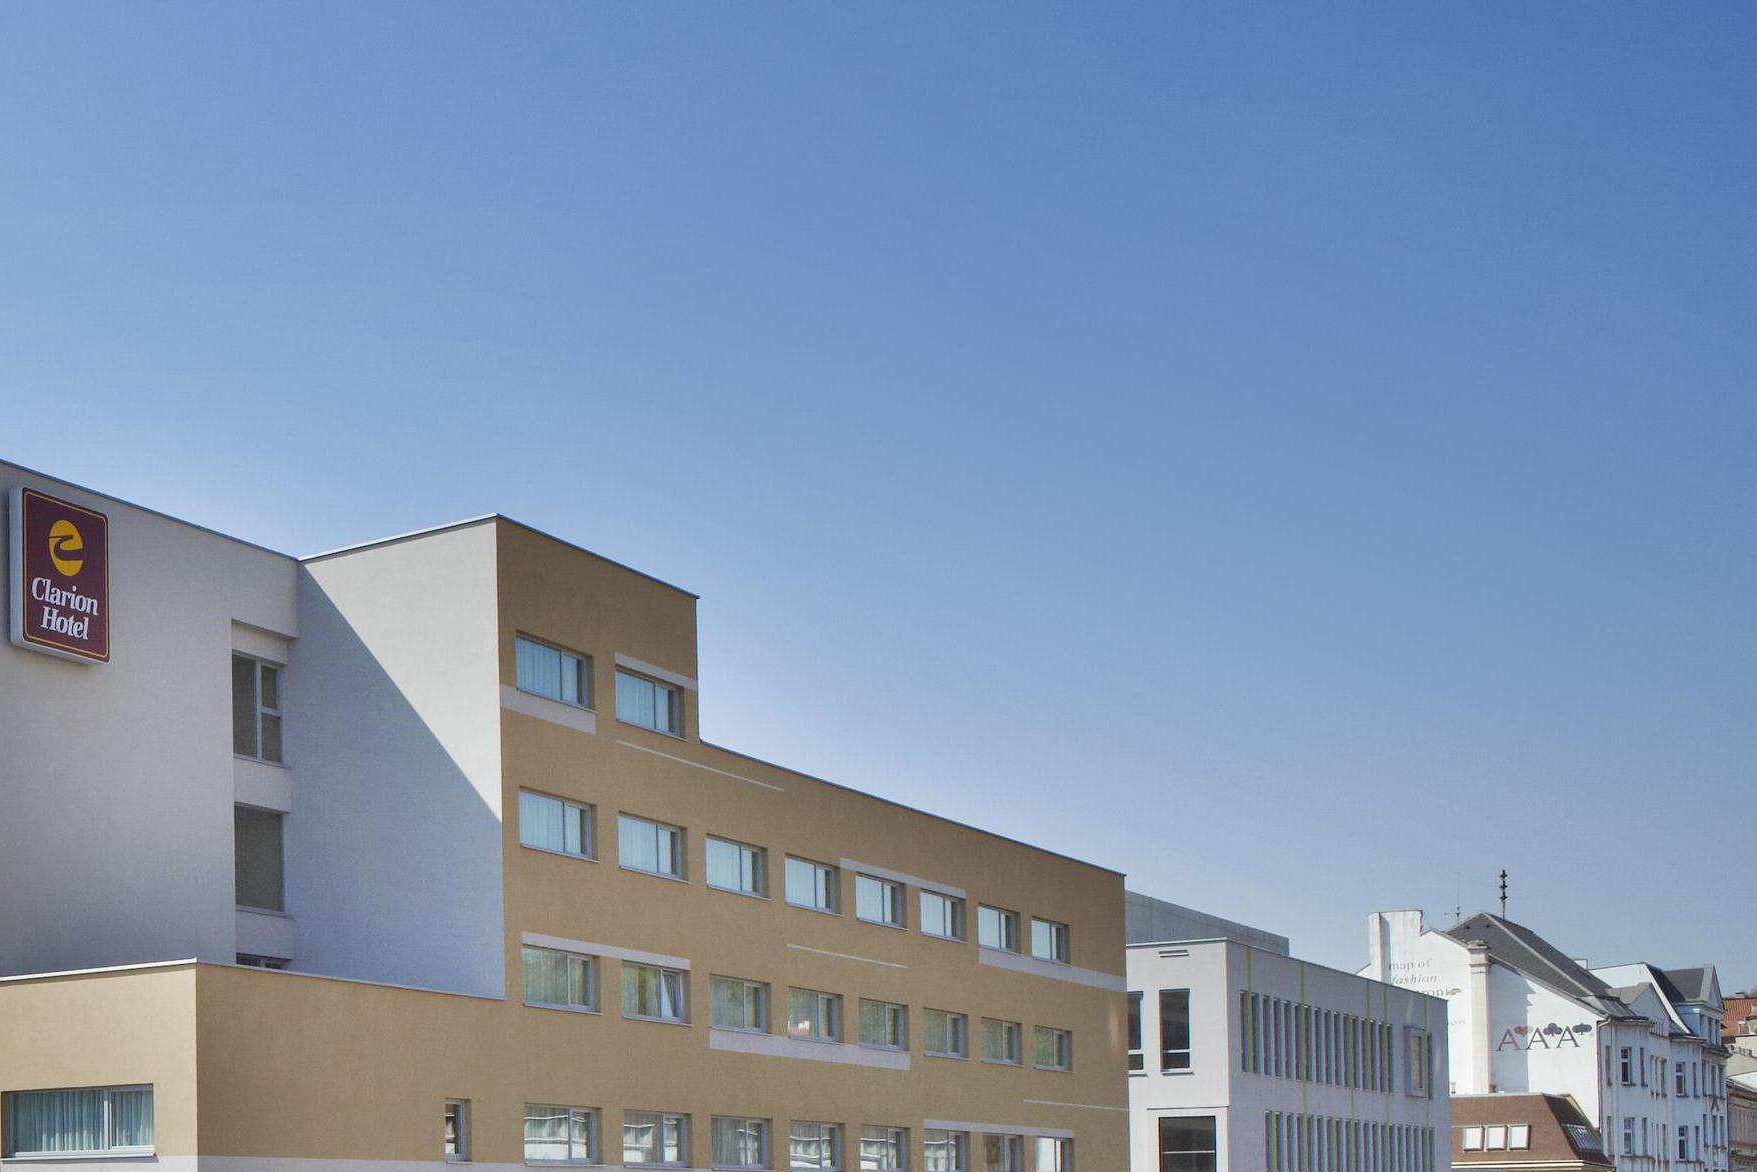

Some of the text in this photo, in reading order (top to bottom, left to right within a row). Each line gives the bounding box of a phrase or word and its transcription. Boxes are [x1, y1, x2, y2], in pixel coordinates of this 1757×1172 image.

[32, 577, 98, 615] Clarion
[40, 606, 89, 640] Hotel
[1389, 960, 1414, 972] map
[1393, 974, 1438, 985] fashion
